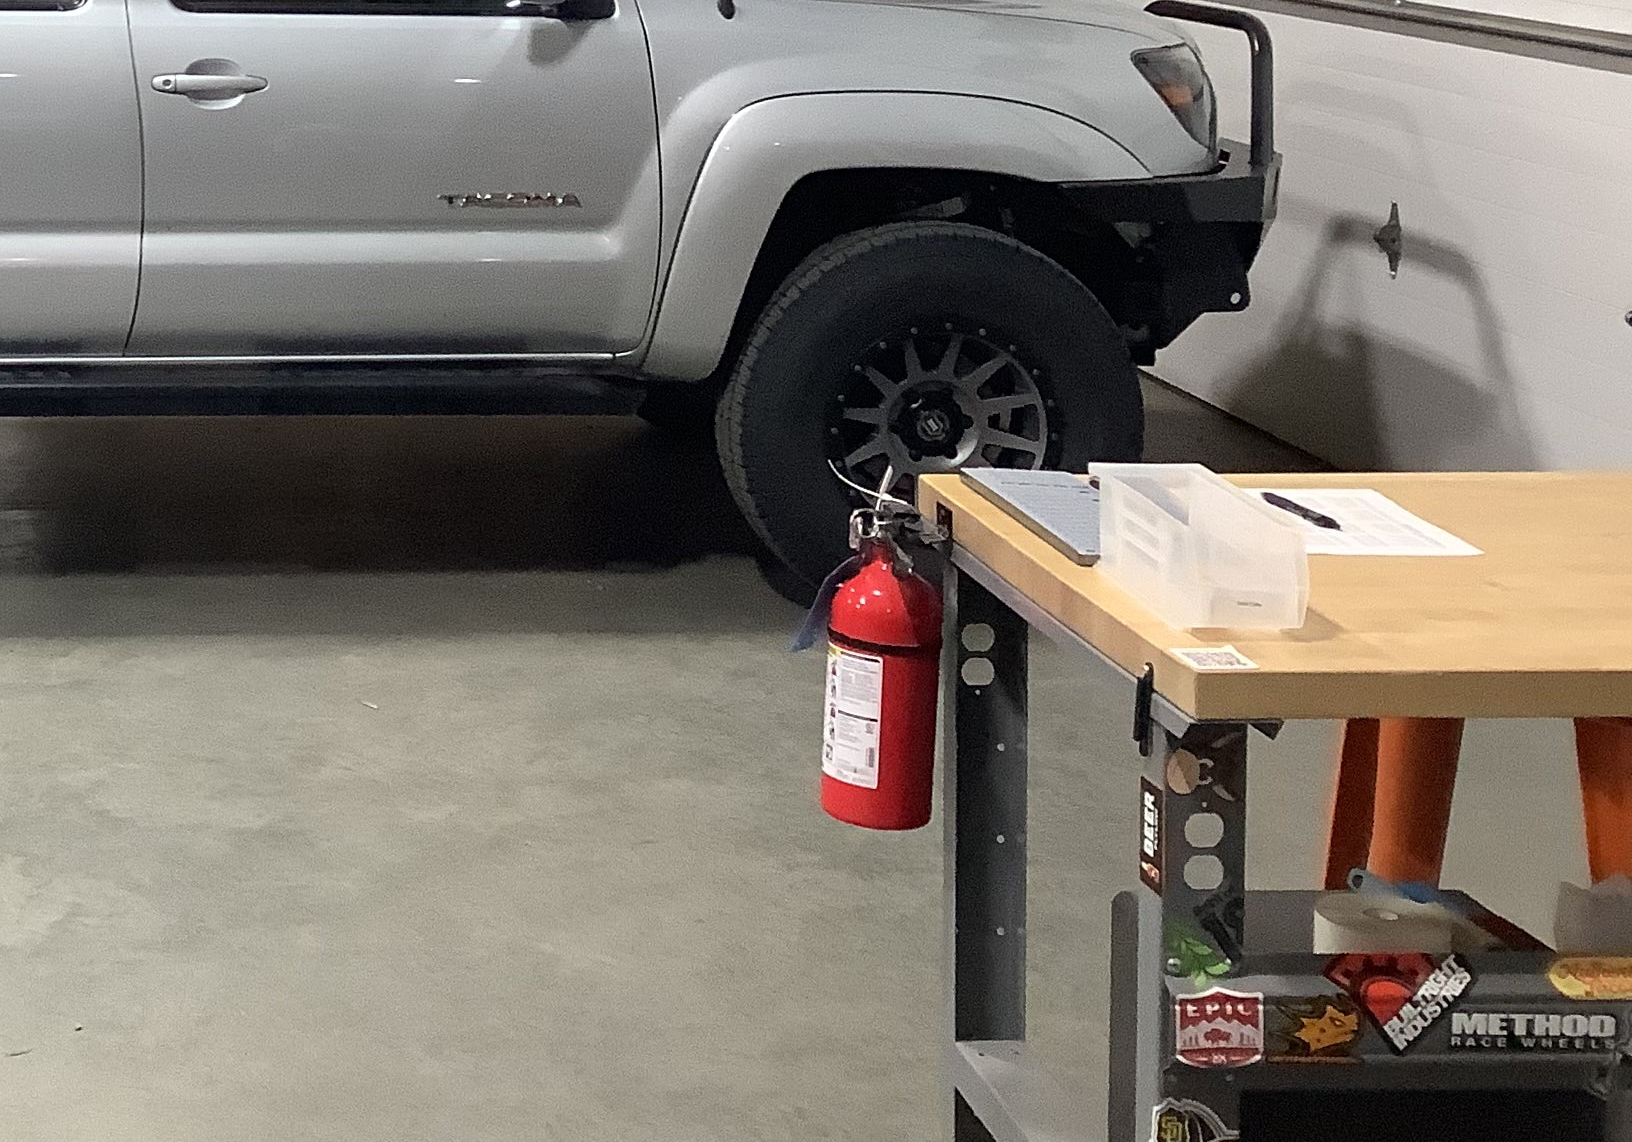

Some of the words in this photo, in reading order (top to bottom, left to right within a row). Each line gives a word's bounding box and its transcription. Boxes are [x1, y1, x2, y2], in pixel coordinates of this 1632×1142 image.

[437, 193, 583, 208] TACOMA
[1143, 791, 1156, 858] BEER
[1186, 1002, 1253, 1017] EPIC
[1392, 970, 1472, 1051] INDUSTRIES
[1451, 1012, 1617, 1037] METHOD
[1450, 1036, 1508, 1048] RACE
[1520, 1037, 1616, 1050] WHEELS
